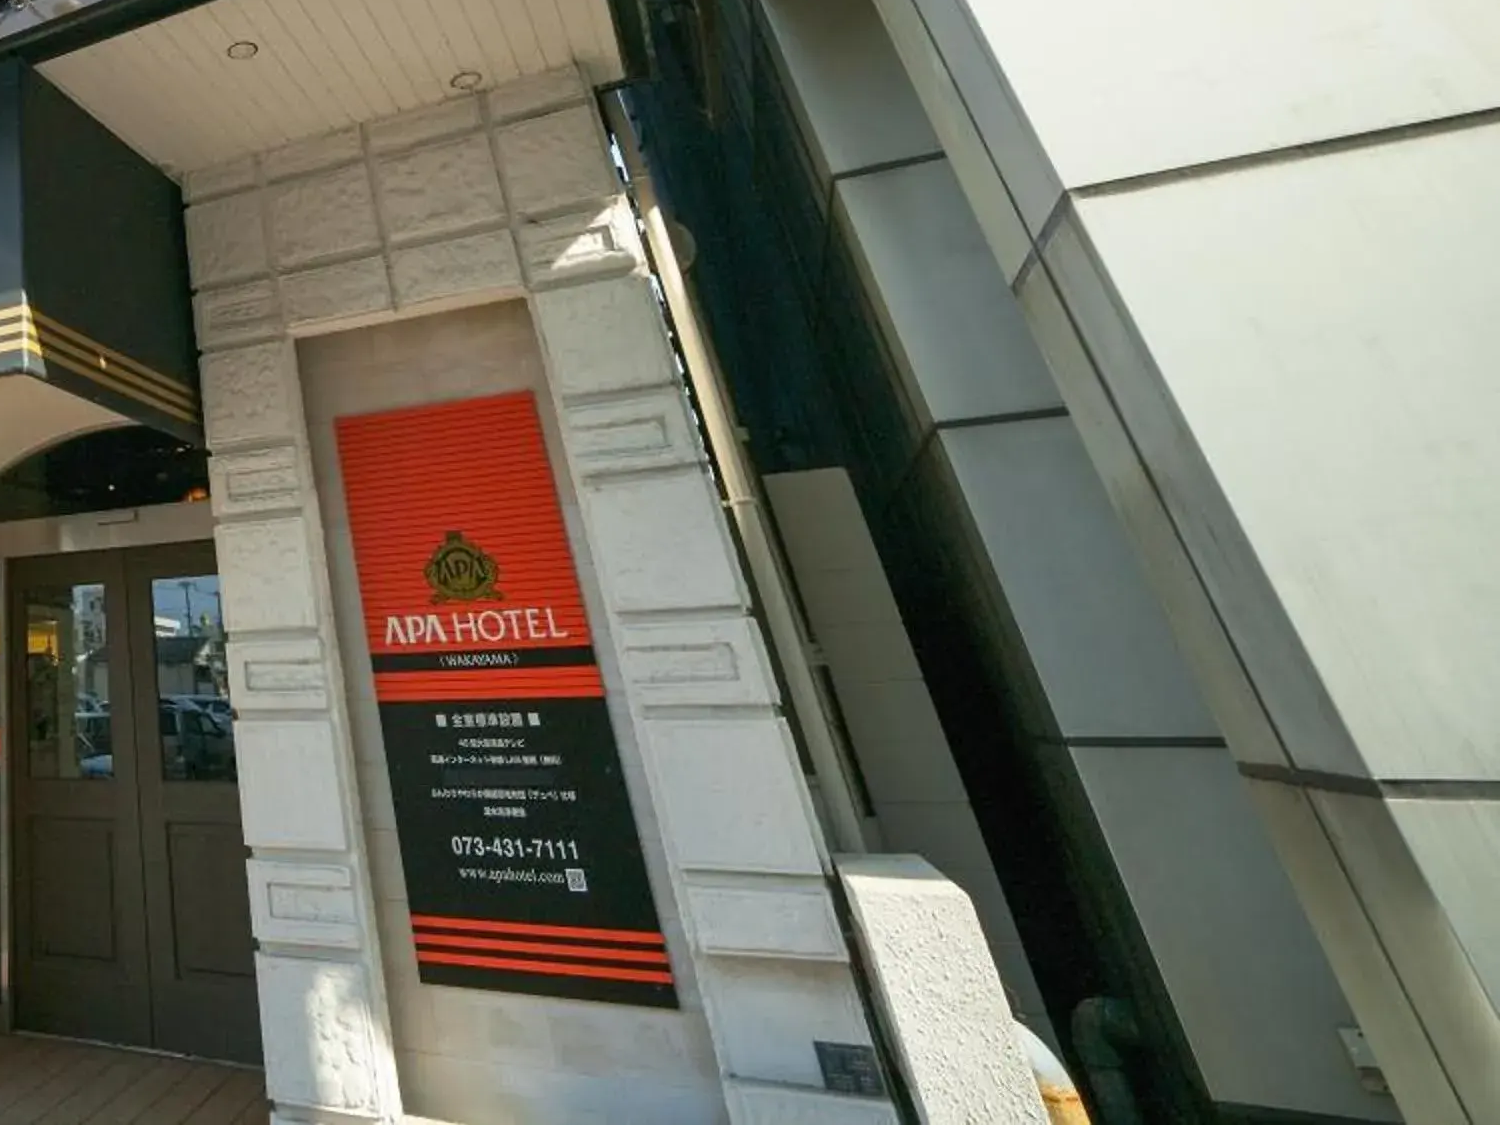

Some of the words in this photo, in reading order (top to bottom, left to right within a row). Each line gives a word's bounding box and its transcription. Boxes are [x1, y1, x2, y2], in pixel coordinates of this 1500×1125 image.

[385, 615, 447, 645] APA
[452, 608, 569, 643] HOTEL
[451, 835, 579, 861] 073-431-7111
